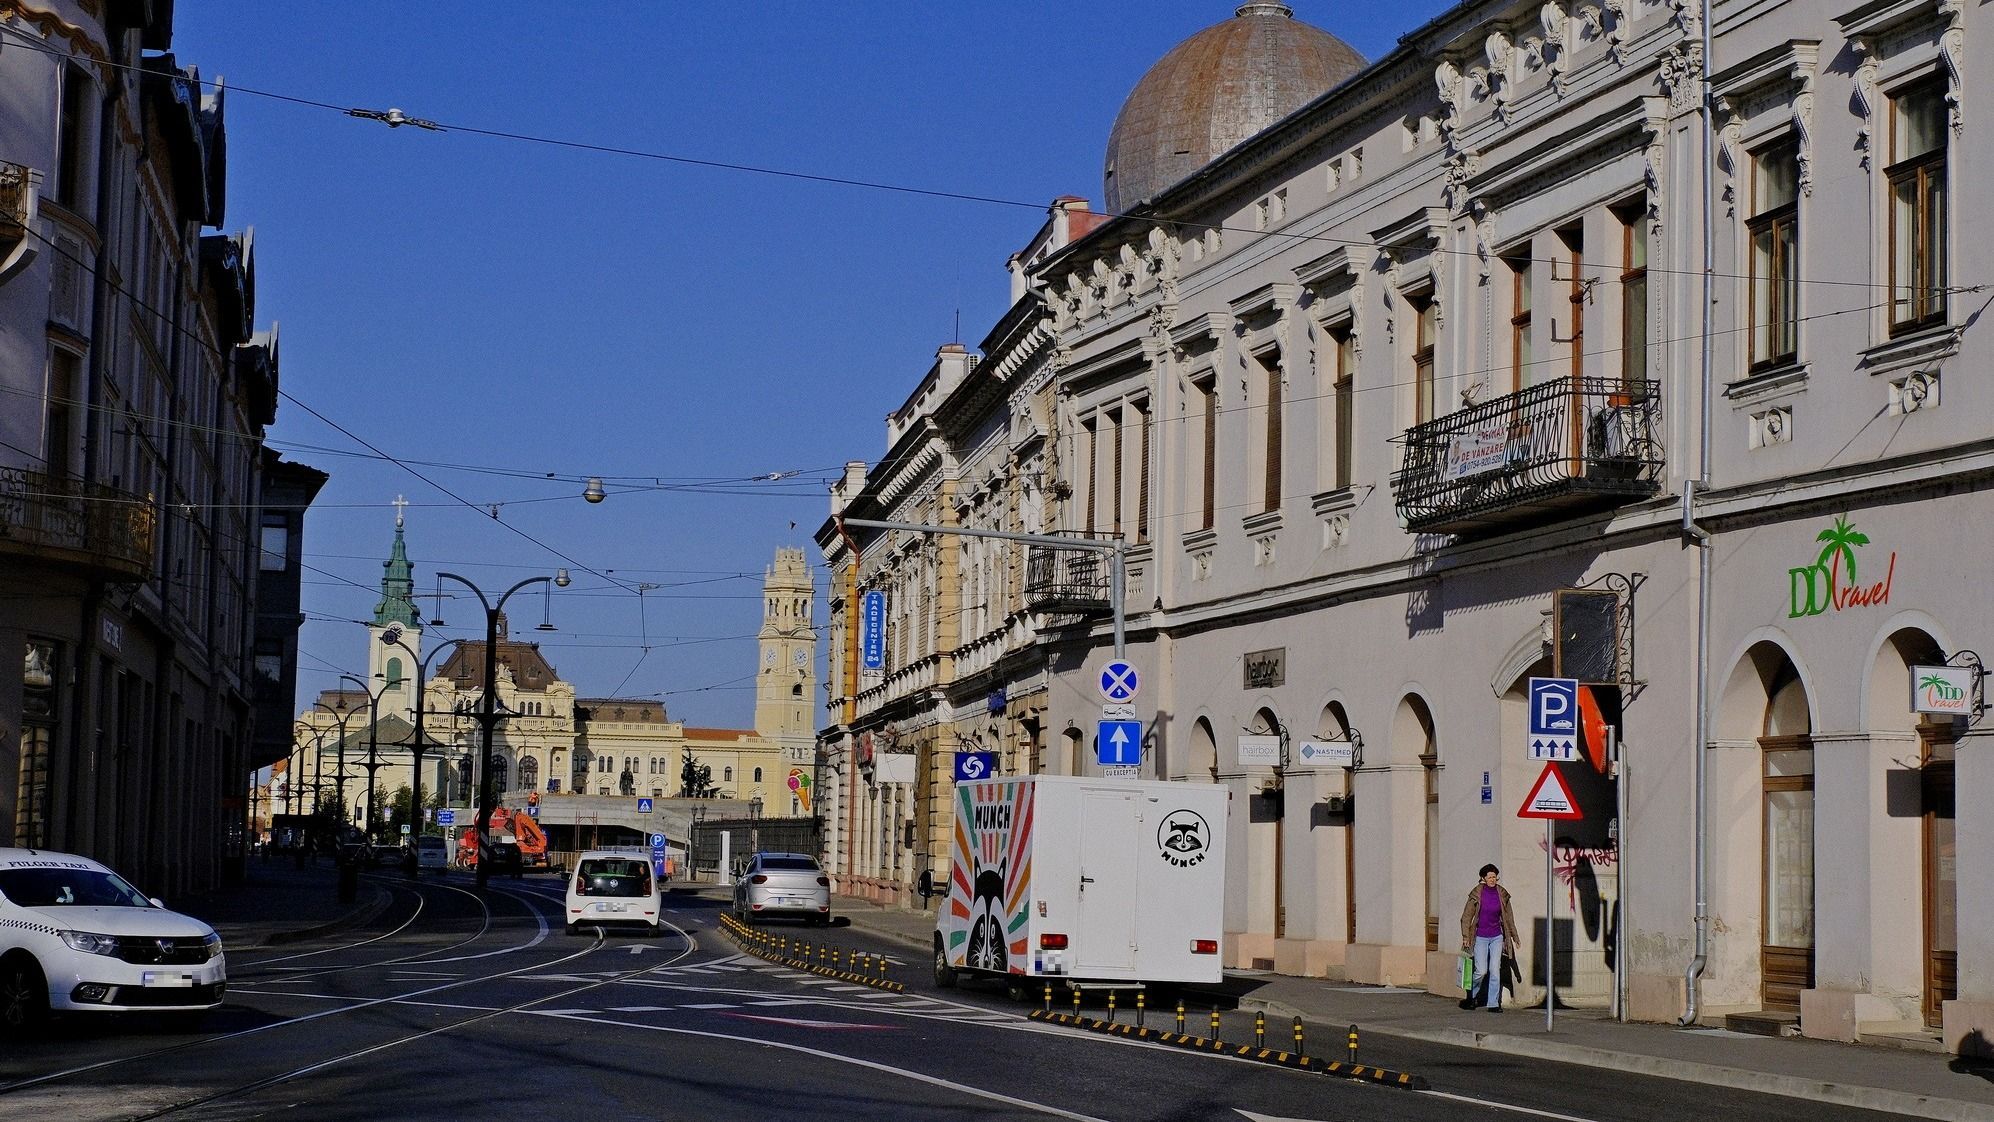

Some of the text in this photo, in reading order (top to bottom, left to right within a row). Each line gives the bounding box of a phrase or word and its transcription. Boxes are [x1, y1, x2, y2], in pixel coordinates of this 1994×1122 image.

[1461, 451, 1470, 462] DE
[1788, 564, 1832, 618] DD
[870, 594, 878, 655] TRADECENTER
[1944, 687, 1964, 700] DD
[1540, 692, 1568, 729] P
[1242, 745, 1274, 755] hairbox
[1315, 747, 1352, 756] NASTIMED
[975, 804, 1011, 830] MUNCH
[654, 835, 662, 846] P
[1161, 850, 1205, 868] MUNCH
